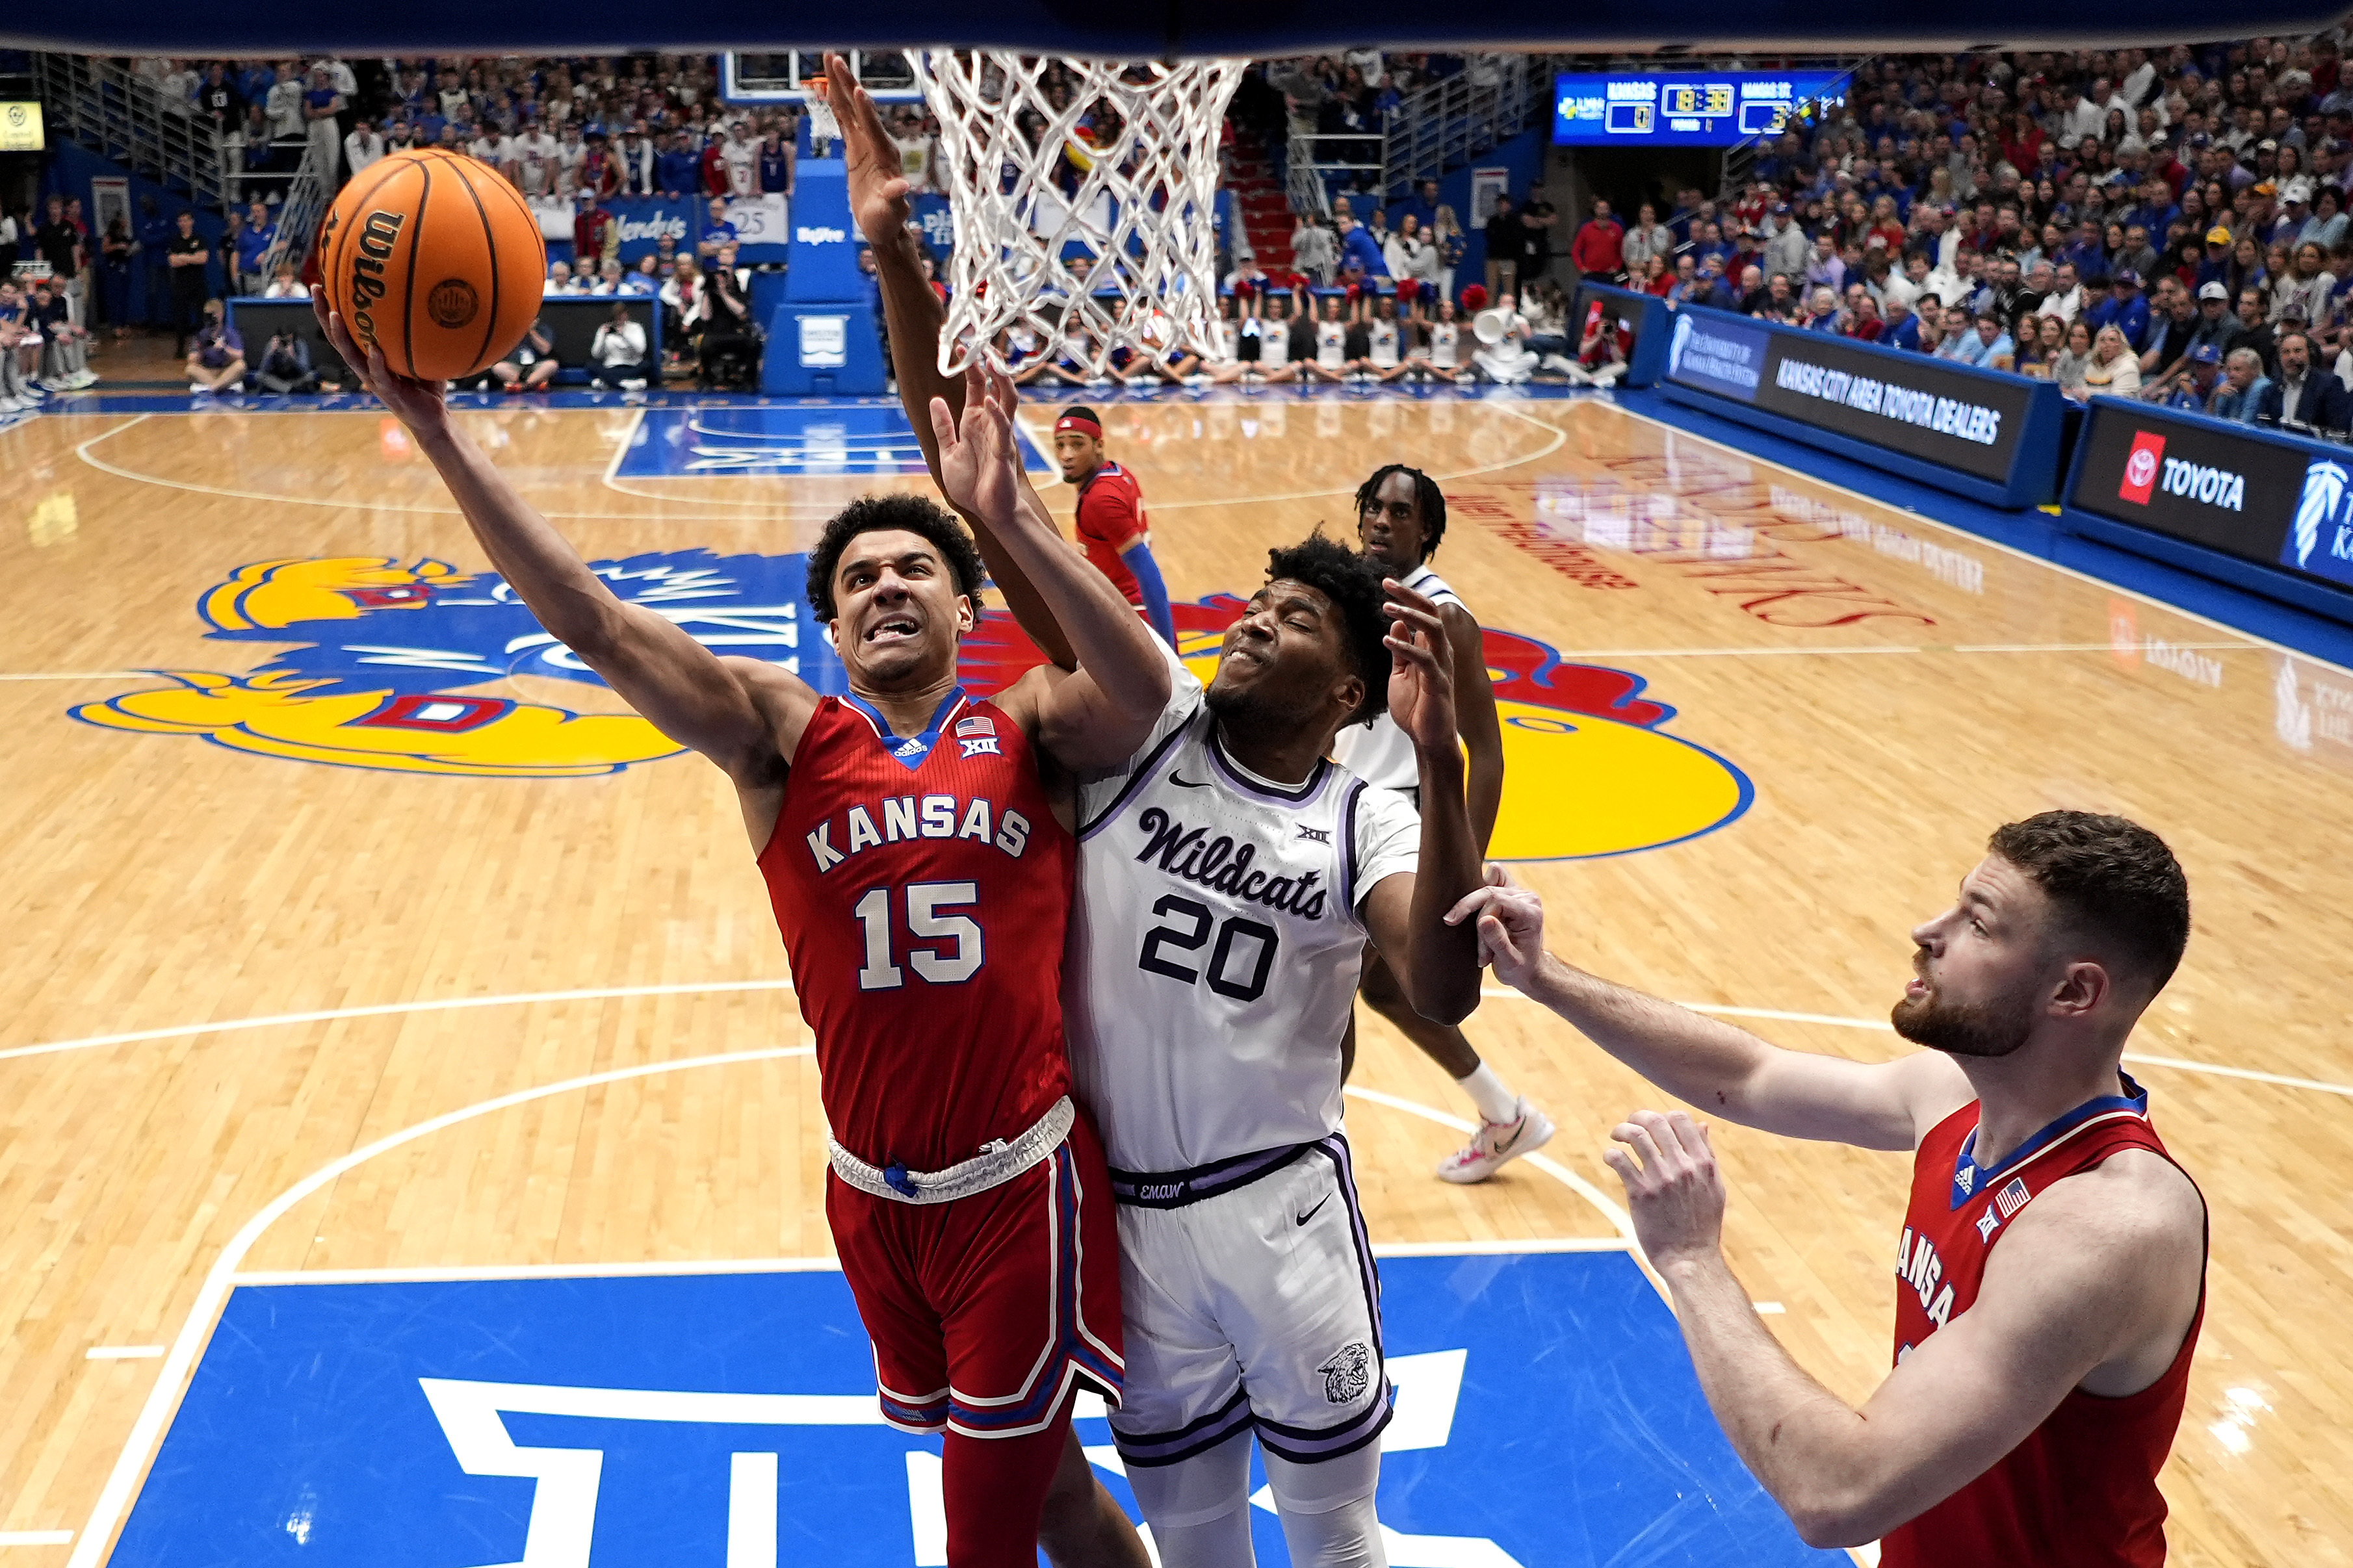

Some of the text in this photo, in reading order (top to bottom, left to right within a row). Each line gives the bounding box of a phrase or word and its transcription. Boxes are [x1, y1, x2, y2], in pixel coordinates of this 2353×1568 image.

[1634, 106, 1649, 128] 0
[1771, 106, 1786, 129] 3
[735, 212, 765, 235] 25
[1776, 357, 2002, 446] KANSAS CITY AREA TOYOTA DEALERS
[2161, 456, 2246, 512] TOYOTA
[894, 745, 928, 757] adidas
[806, 794, 1031, 874] KANSAS
[1134, 806, 1328, 921] Wildcats
[853, 879, 986, 992] 15
[1138, 893, 1280, 1003] 20
[1895, 1225, 1956, 1331] ANSA
